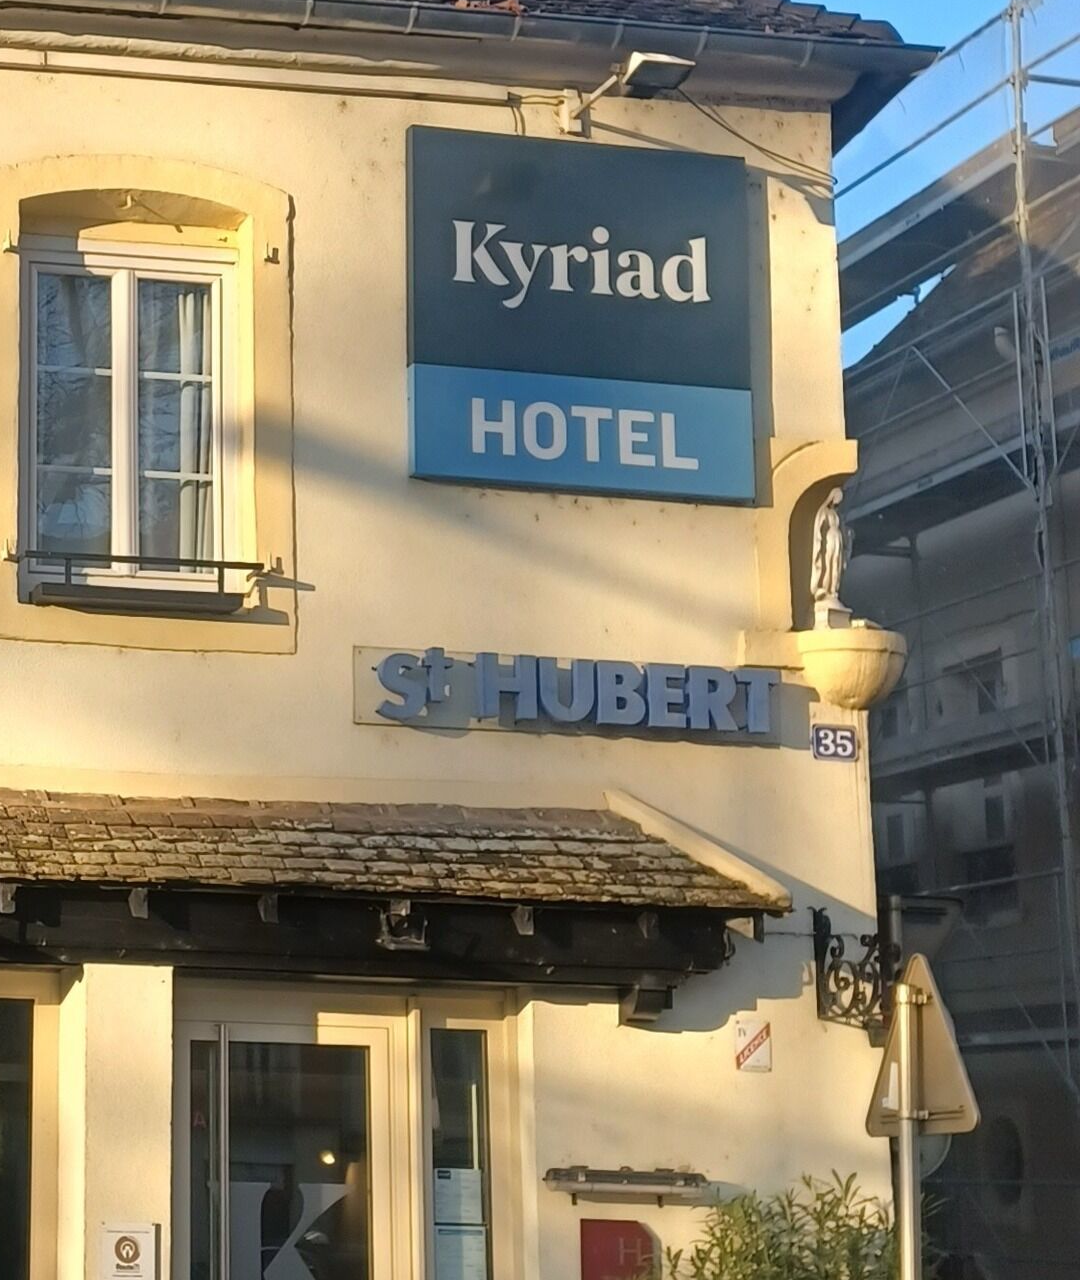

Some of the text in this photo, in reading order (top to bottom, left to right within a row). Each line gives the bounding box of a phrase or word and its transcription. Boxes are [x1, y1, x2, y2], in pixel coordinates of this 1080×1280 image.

[452, 219, 711, 309] Kyriad
[470, 397, 700, 472] HOTEL
[375, 647, 780, 735] St HUBERT
[818, 730, 854, 758] 35
